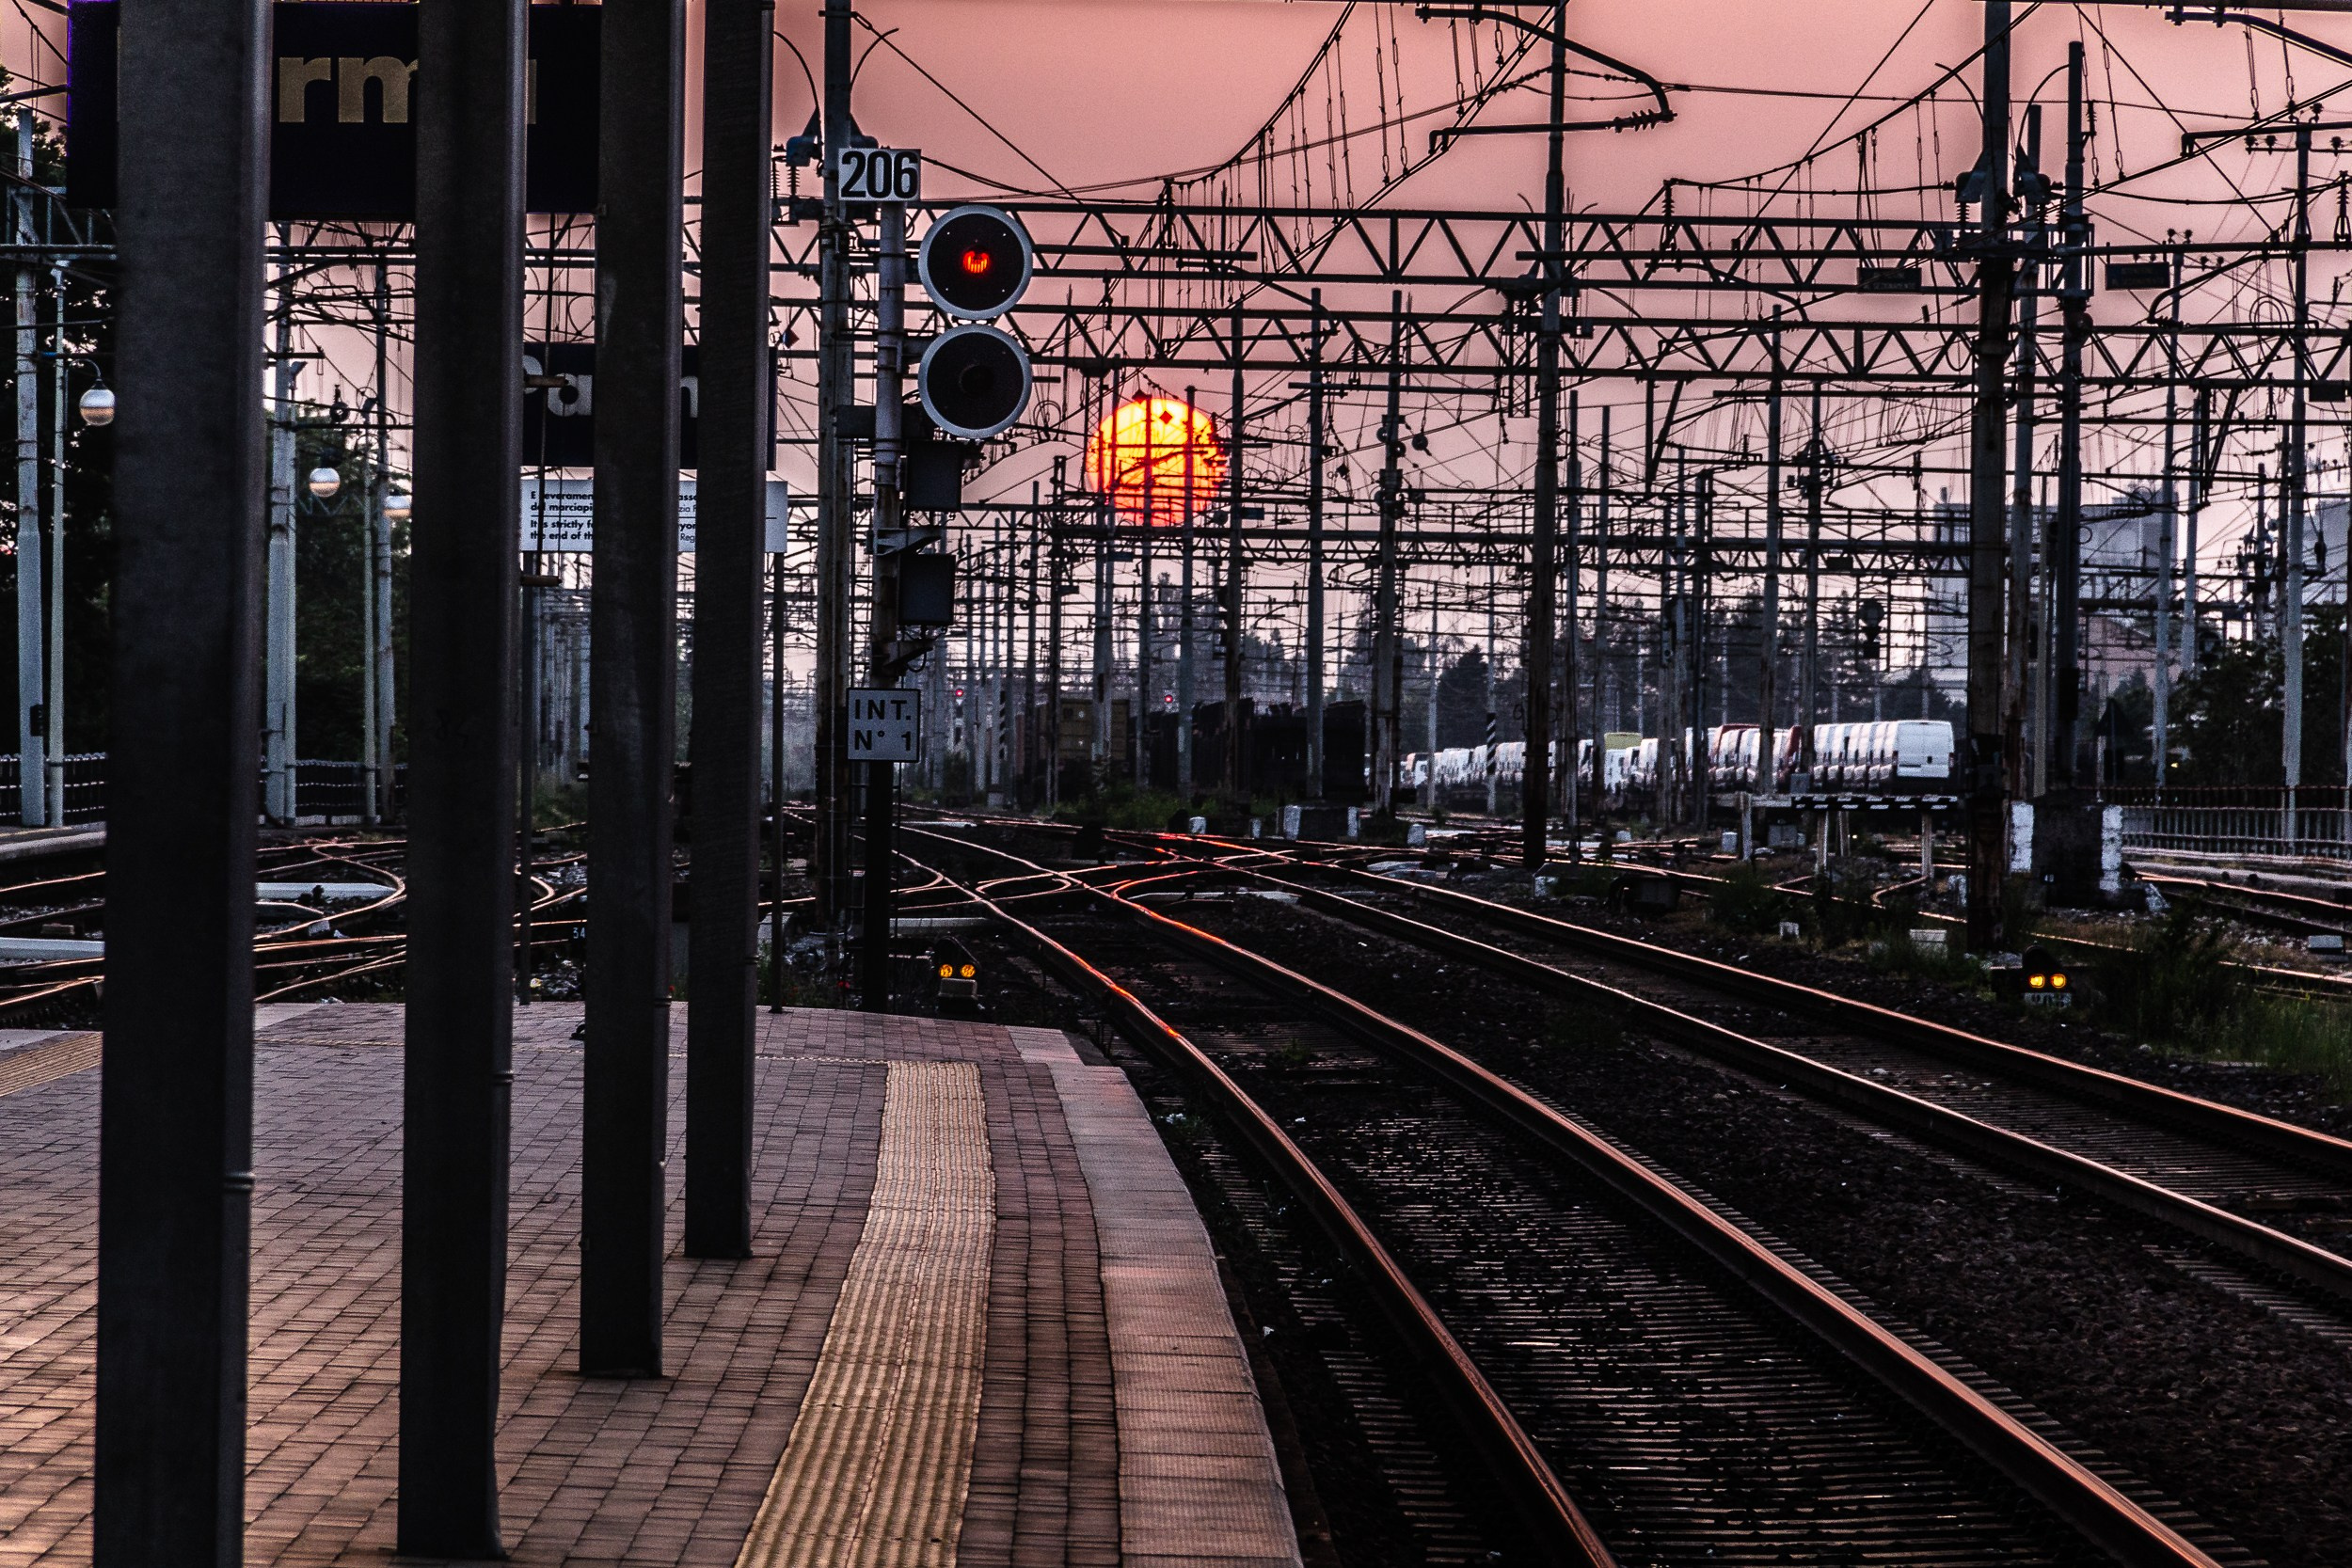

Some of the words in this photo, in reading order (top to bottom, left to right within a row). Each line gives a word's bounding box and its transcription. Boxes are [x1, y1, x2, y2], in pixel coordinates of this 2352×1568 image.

[841, 150, 918, 199] 206
[548, 502, 593, 514] marciapi
[531, 519, 537, 528] It
[551, 519, 583, 531] strictly
[548, 531, 568, 540] end
[570, 531, 581, 540] of
[583, 531, 594, 540] th
[854, 699, 912, 721] INT.
[854, 729, 885, 751] N°
[900, 730, 912, 752] 1
[572, 927, 586, 940] 34
